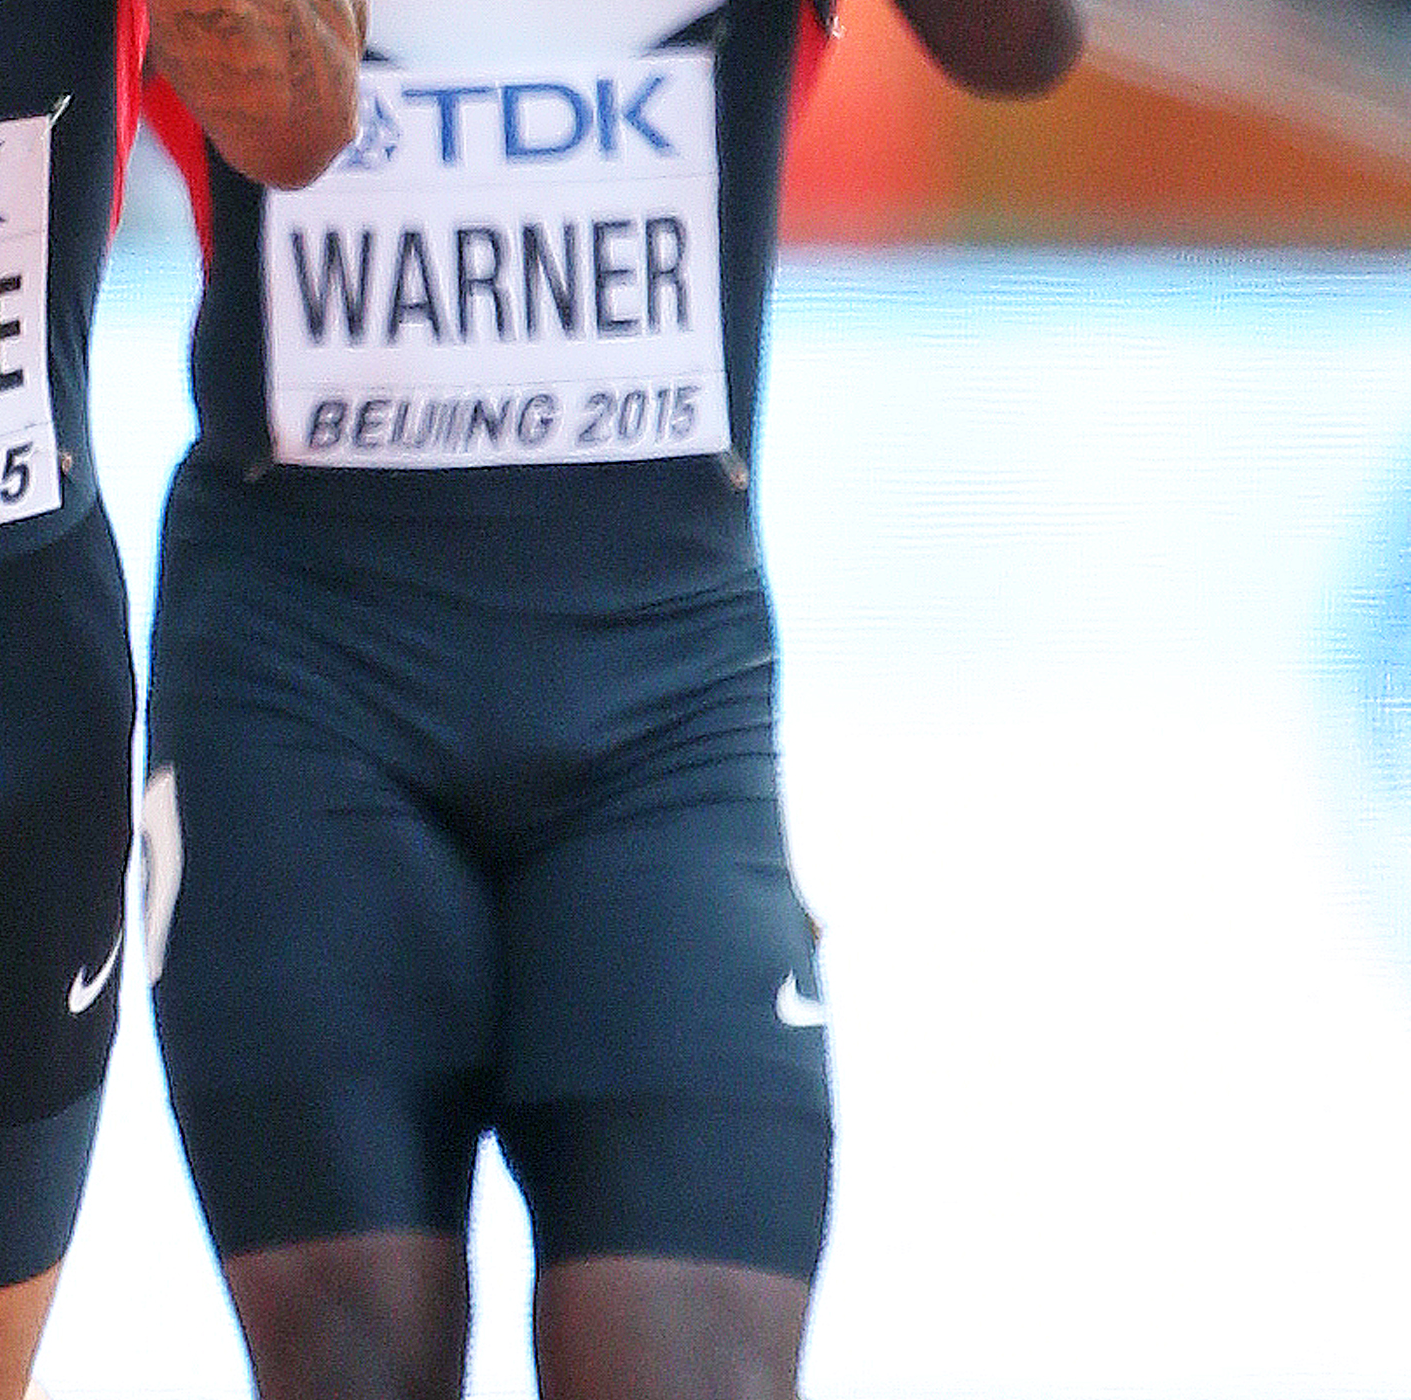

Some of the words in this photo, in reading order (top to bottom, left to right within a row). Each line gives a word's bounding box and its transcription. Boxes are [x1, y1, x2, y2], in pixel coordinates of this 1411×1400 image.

[400, 74, 678, 166] TDK
[289, 214, 694, 346] WARNER
[305, 397, 558, 450] BEIJING
[577, 386, 702, 445] 2015
